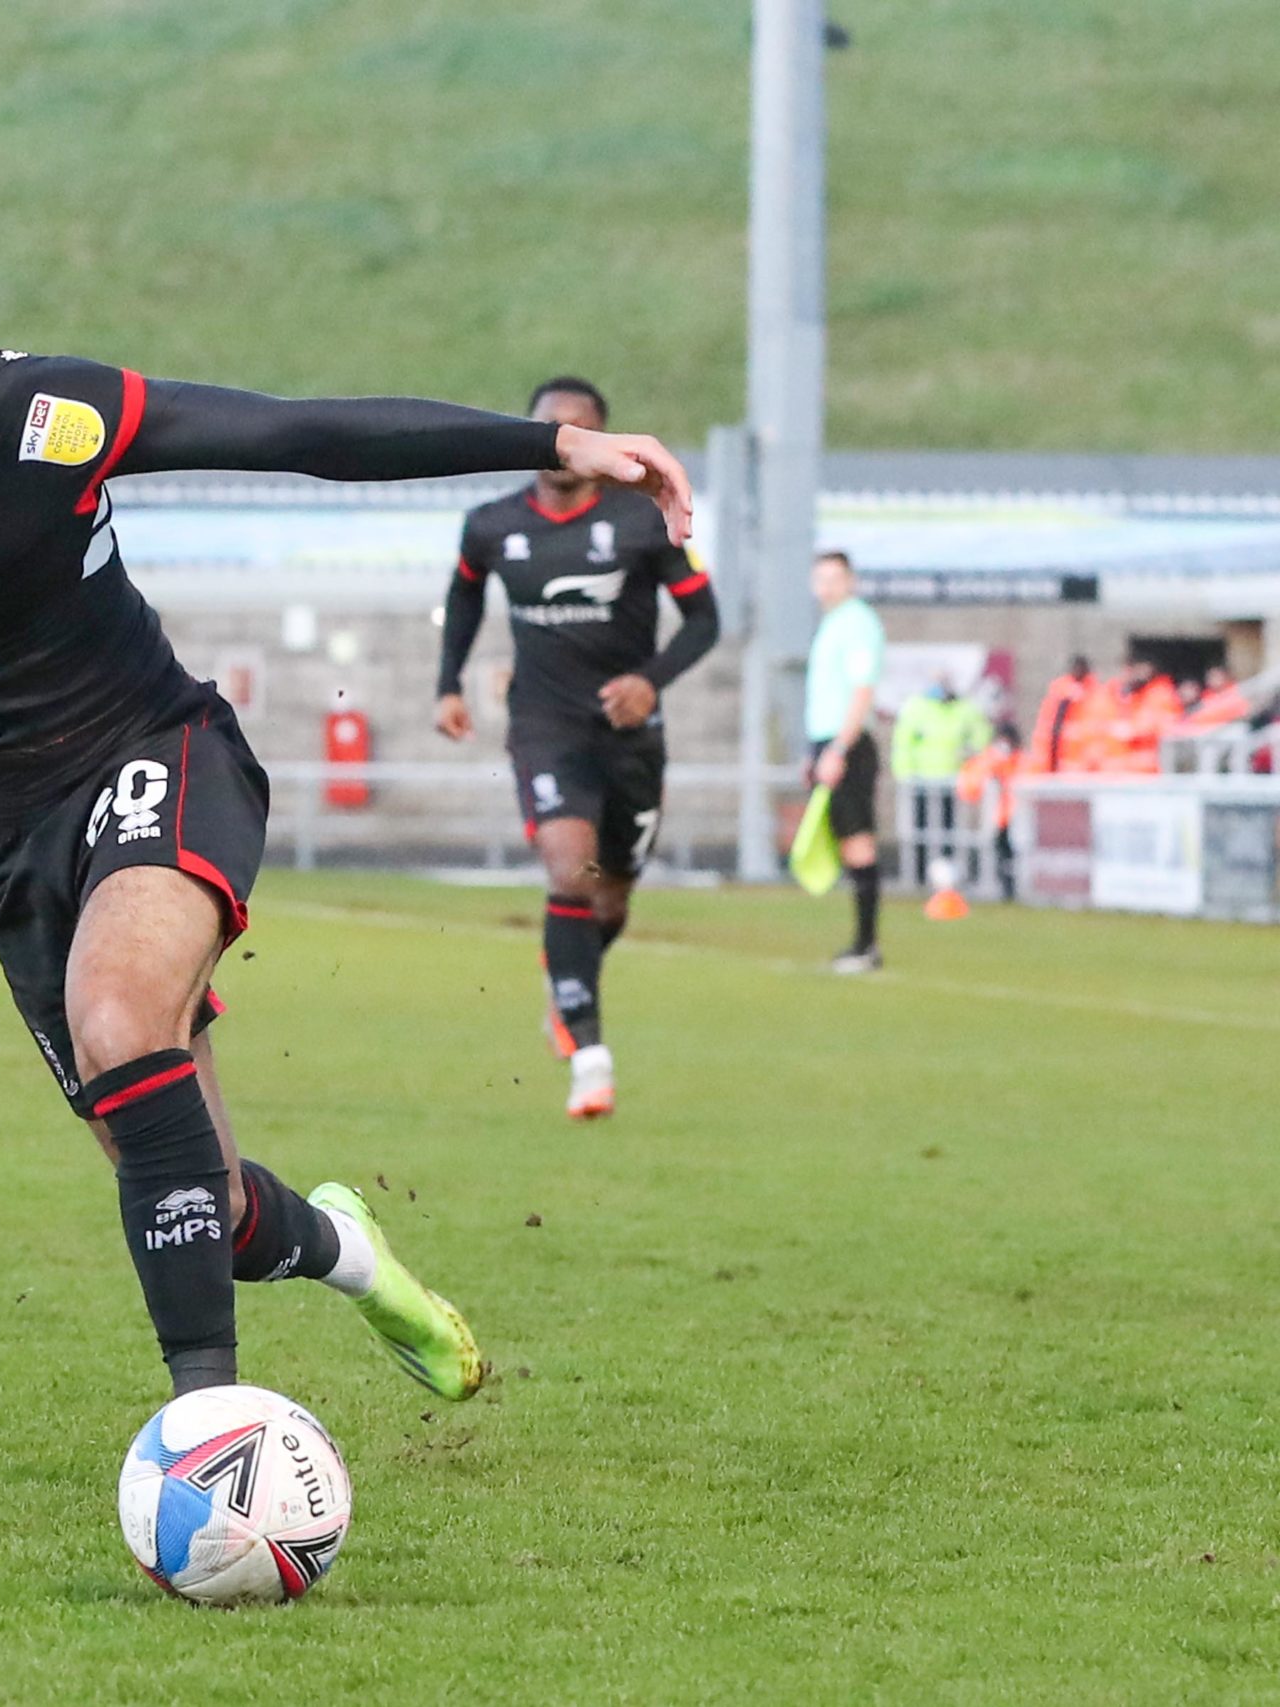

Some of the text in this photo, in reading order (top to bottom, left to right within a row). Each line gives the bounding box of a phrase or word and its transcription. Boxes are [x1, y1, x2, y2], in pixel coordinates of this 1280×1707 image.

[26, 400, 50, 454] sky bet
[48, 427, 58, 446] STAY
[70, 417, 84, 453] DEPOSIT
[145, 1218, 221, 1250] IMPS
[282, 1433, 325, 1518] mitre
